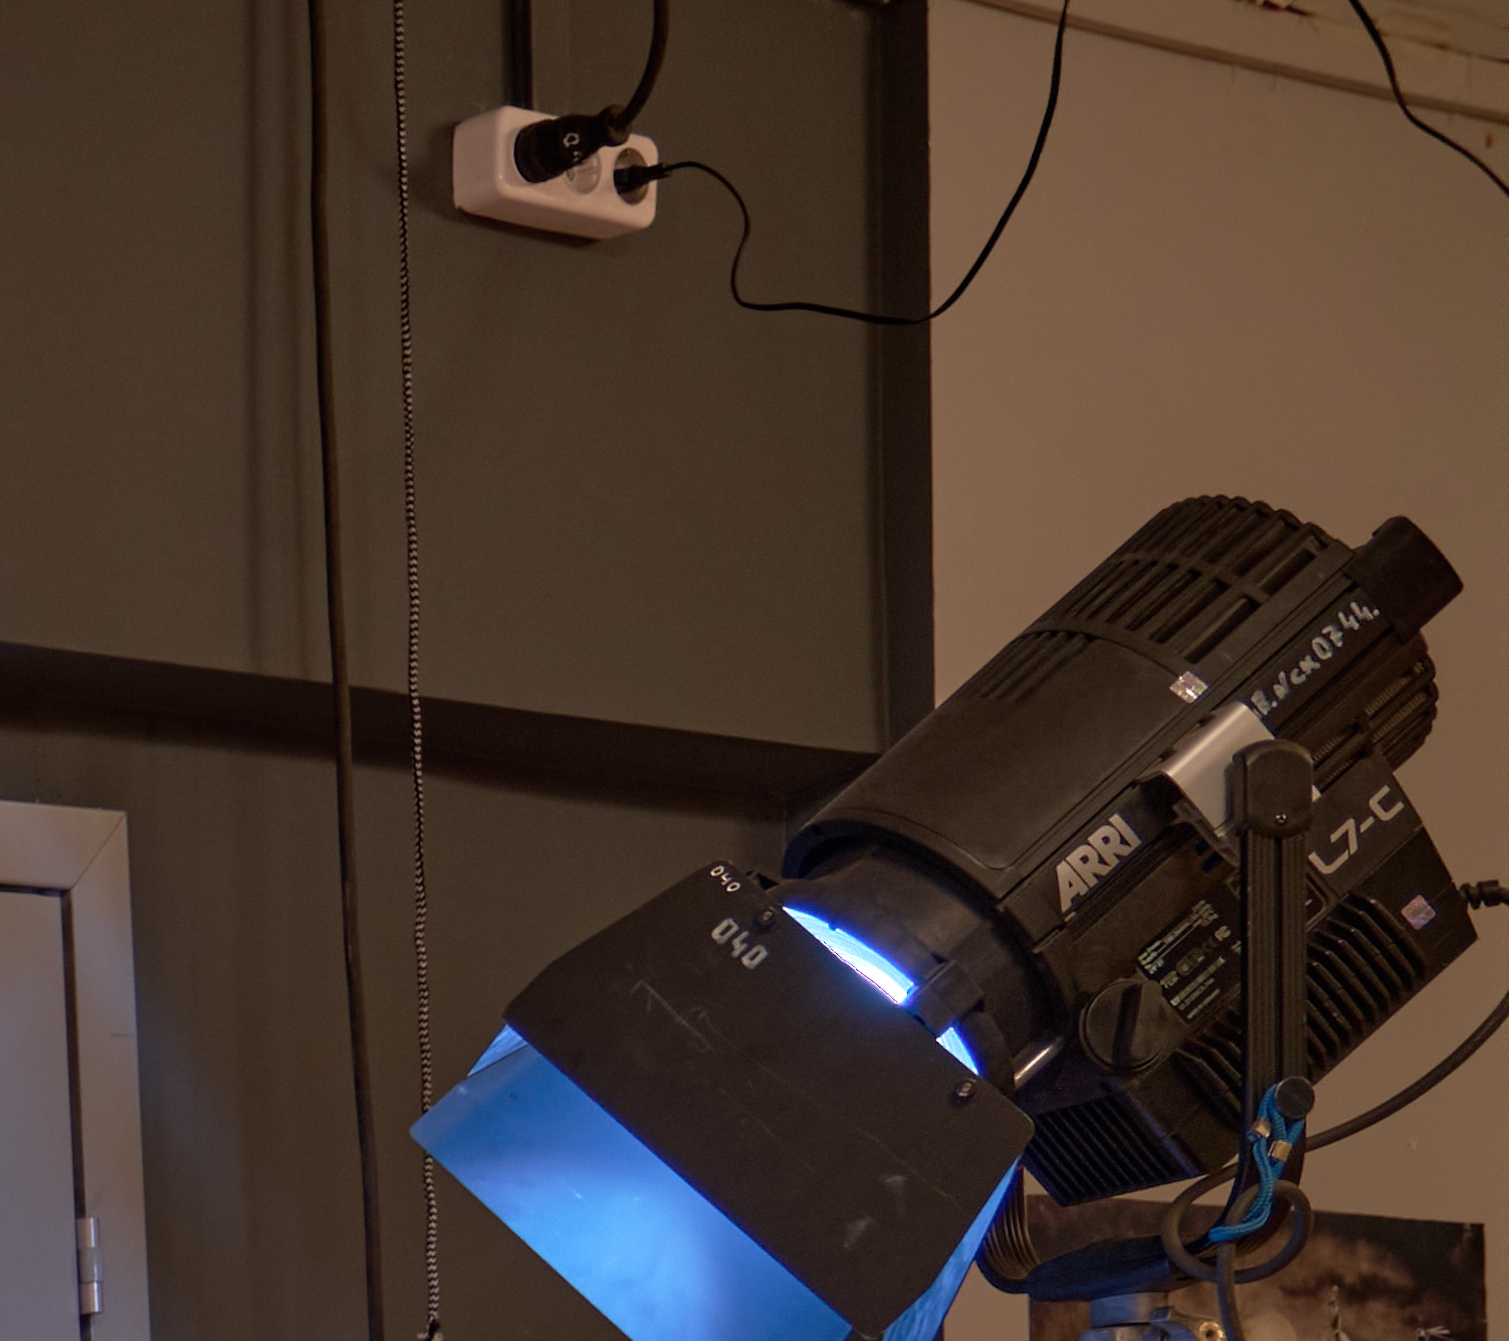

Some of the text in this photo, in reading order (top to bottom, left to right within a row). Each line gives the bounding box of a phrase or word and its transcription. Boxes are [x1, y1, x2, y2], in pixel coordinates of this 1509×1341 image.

[1055, 814, 1142, 917] ARRI
[1308, 786, 1404, 877] L7-C
[710, 914, 770, 970] 040
